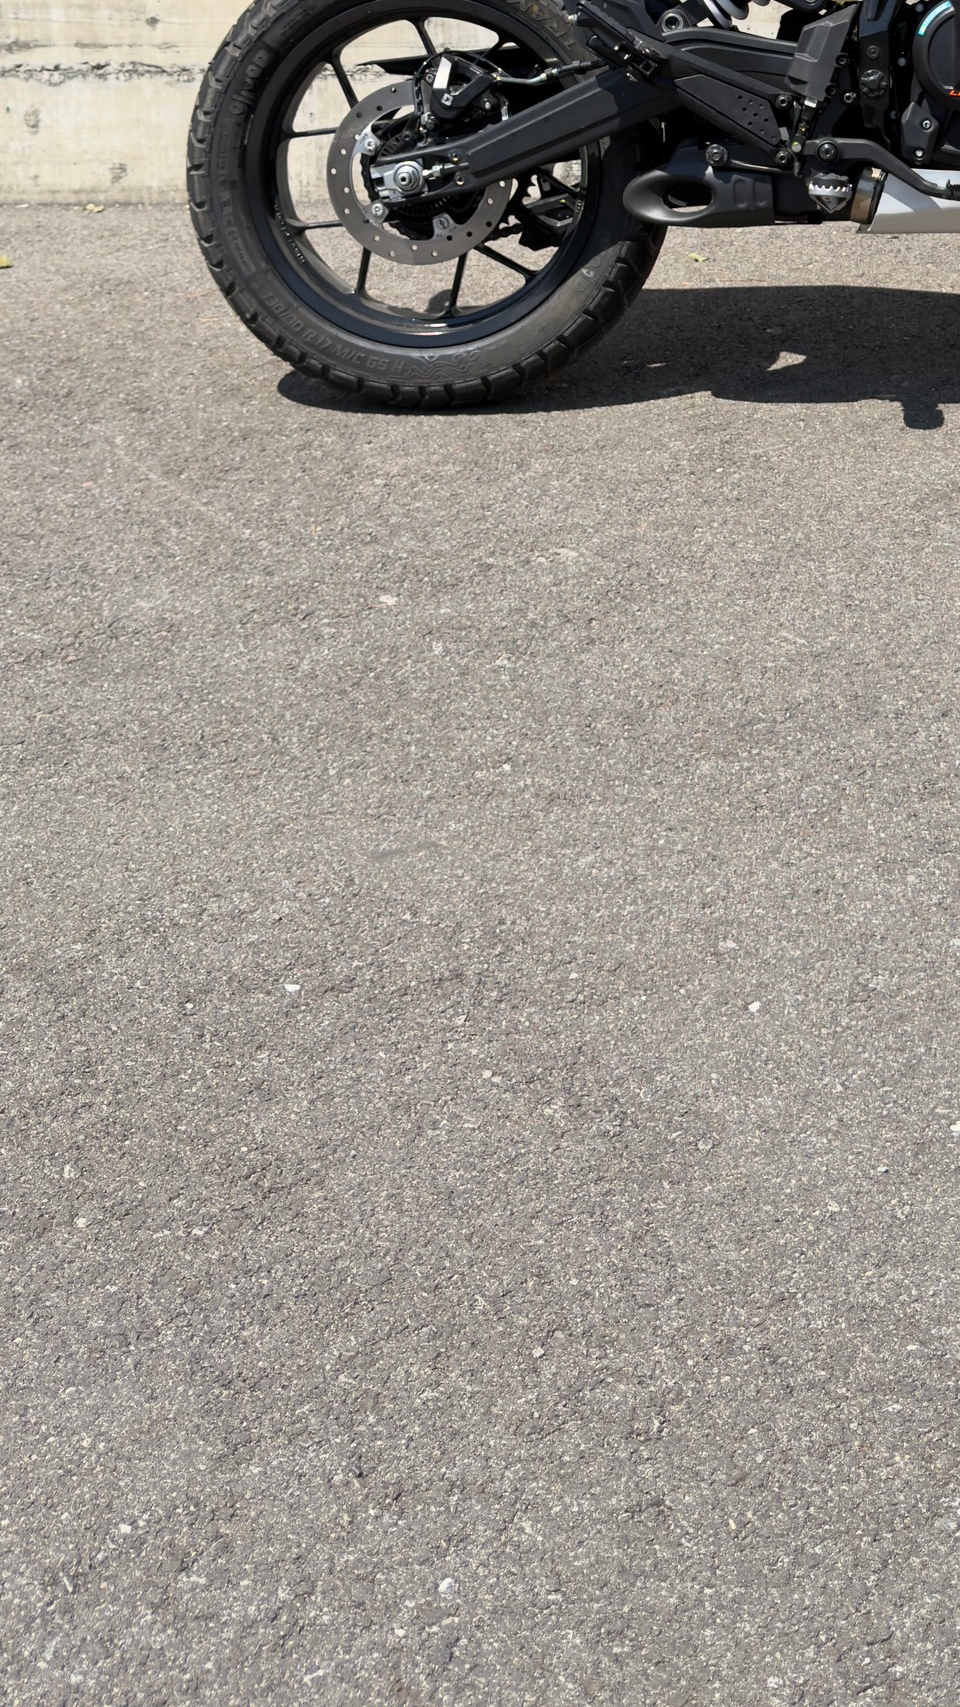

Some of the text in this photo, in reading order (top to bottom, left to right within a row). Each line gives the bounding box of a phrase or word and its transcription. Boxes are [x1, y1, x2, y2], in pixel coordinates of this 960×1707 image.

[331, 344, 366, 365] M/C
[367, 356, 390, 371] 65
[391, 359, 406, 373] H
